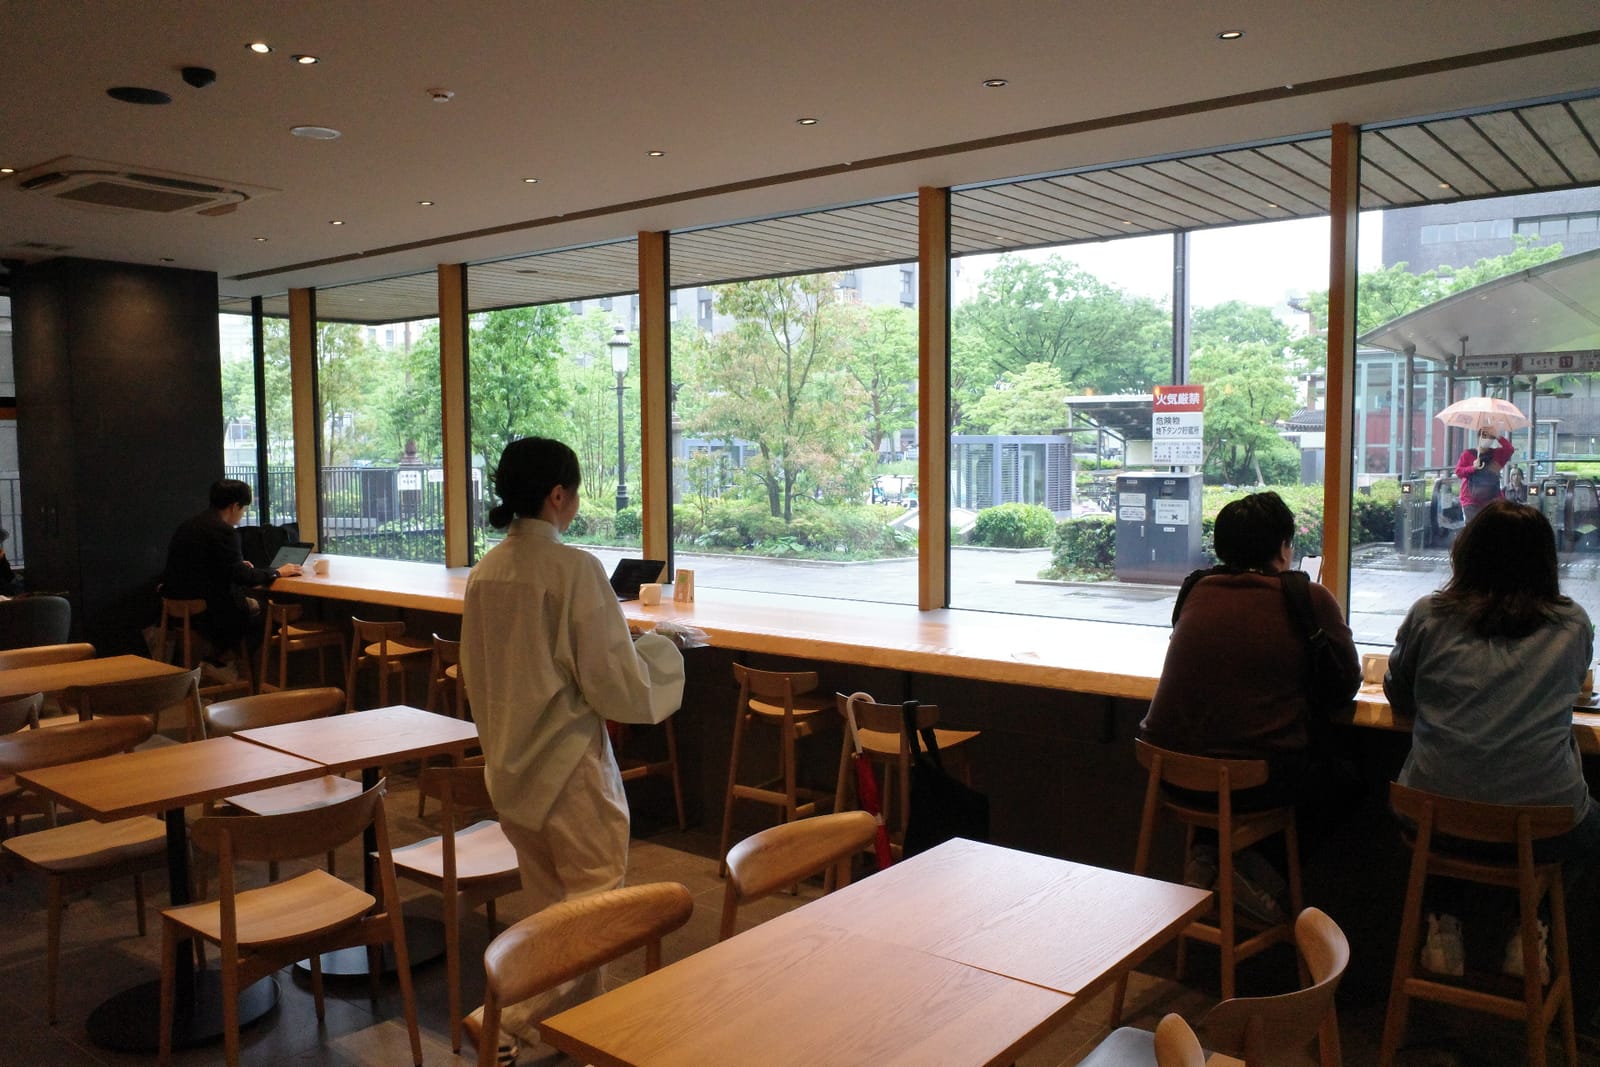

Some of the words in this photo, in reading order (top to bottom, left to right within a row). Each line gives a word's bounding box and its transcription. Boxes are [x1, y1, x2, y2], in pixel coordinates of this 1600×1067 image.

[1156, 393, 1200, 405] 火気厳禁
[1156, 416, 1180, 426] 危険物
